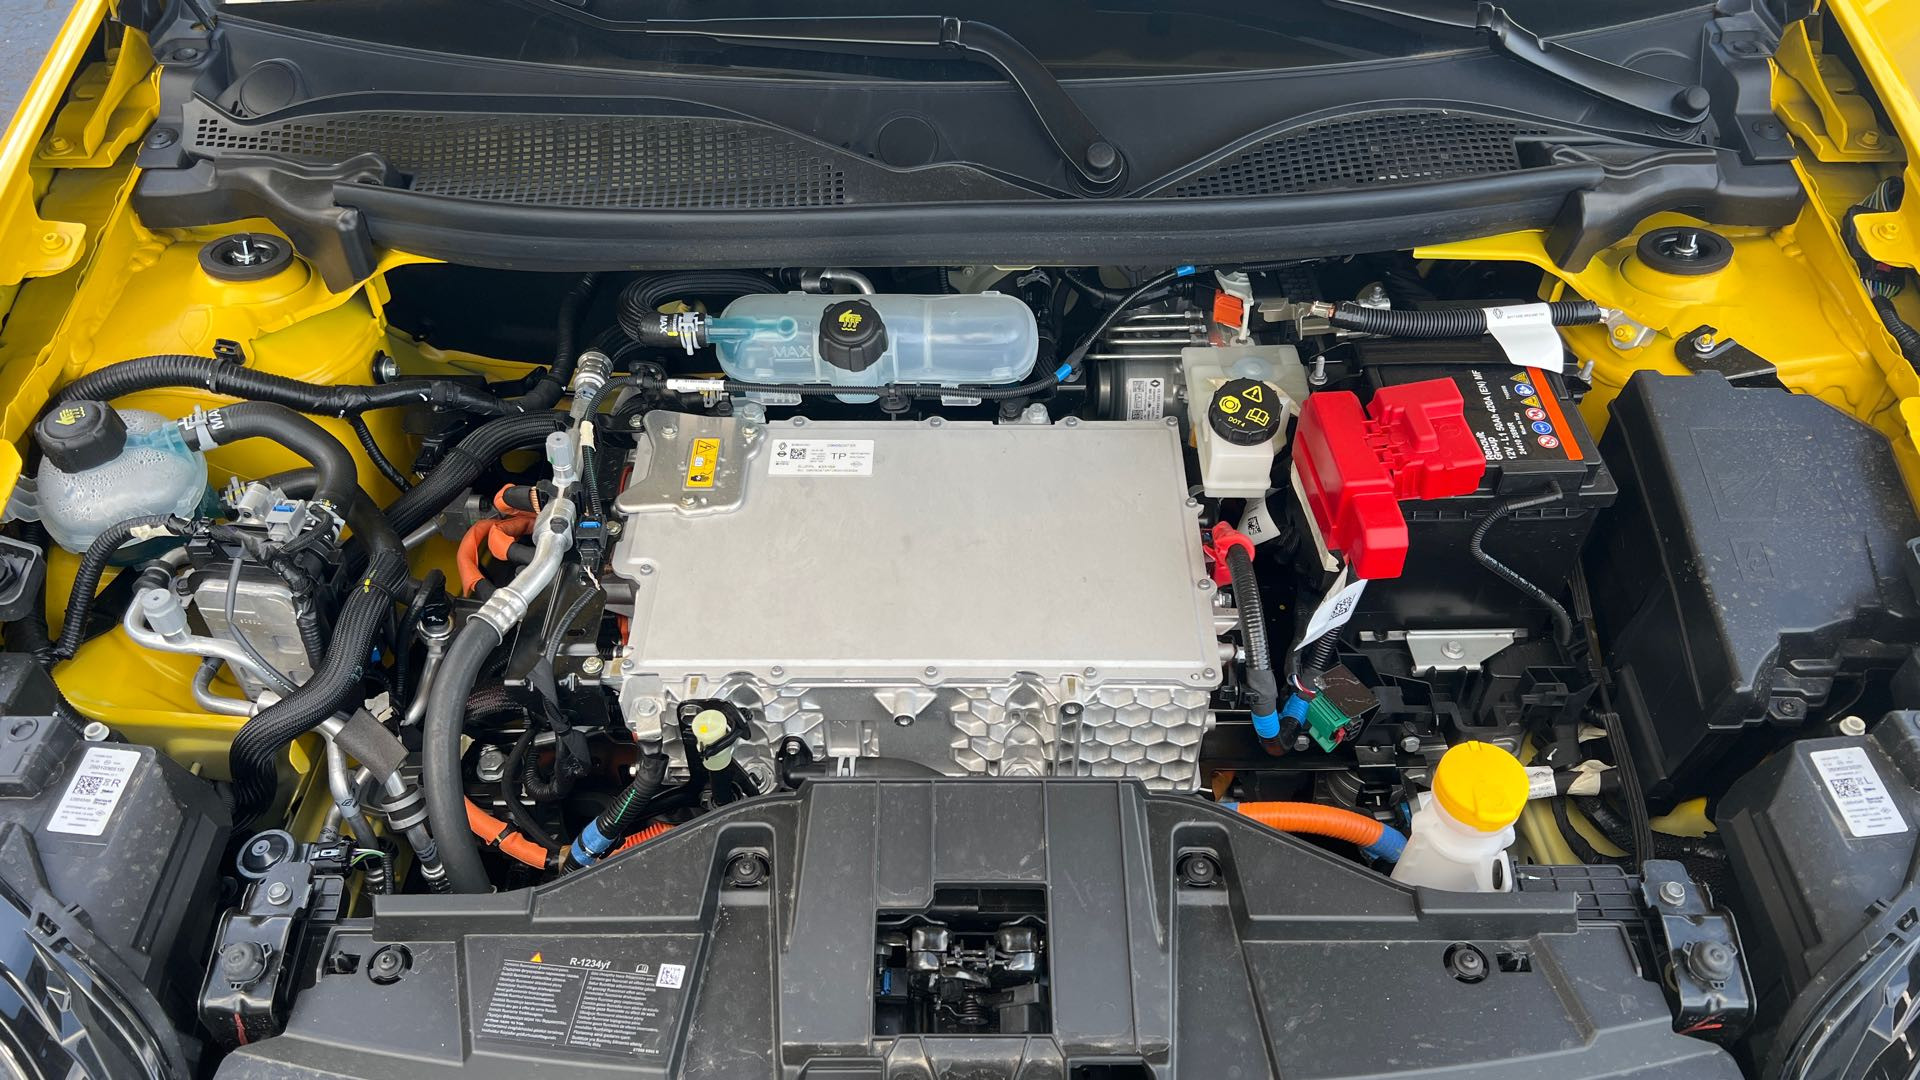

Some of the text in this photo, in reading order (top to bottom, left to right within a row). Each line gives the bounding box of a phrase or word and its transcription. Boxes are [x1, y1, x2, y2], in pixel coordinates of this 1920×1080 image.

[660, 315, 669, 334] MAX
[772, 345, 812, 358] MAX
[1471, 369, 1483, 380] MF
[1476, 380, 1492, 395] (EN)
[1483, 395, 1497, 413] 420A
[208, 408, 225, 430] MA
[1228, 416, 1242, 426] DOT
[1491, 413, 1505, 432] 50Ah
[1475, 431, 1495, 460] Renault
[1487, 436, 1503, 460] Group
[831, 452, 847, 460] TP
[1504, 446, 1517, 460] 12V
[111, 778, 121, 787] R
[569, 957, 611, 970] R-1234yf
